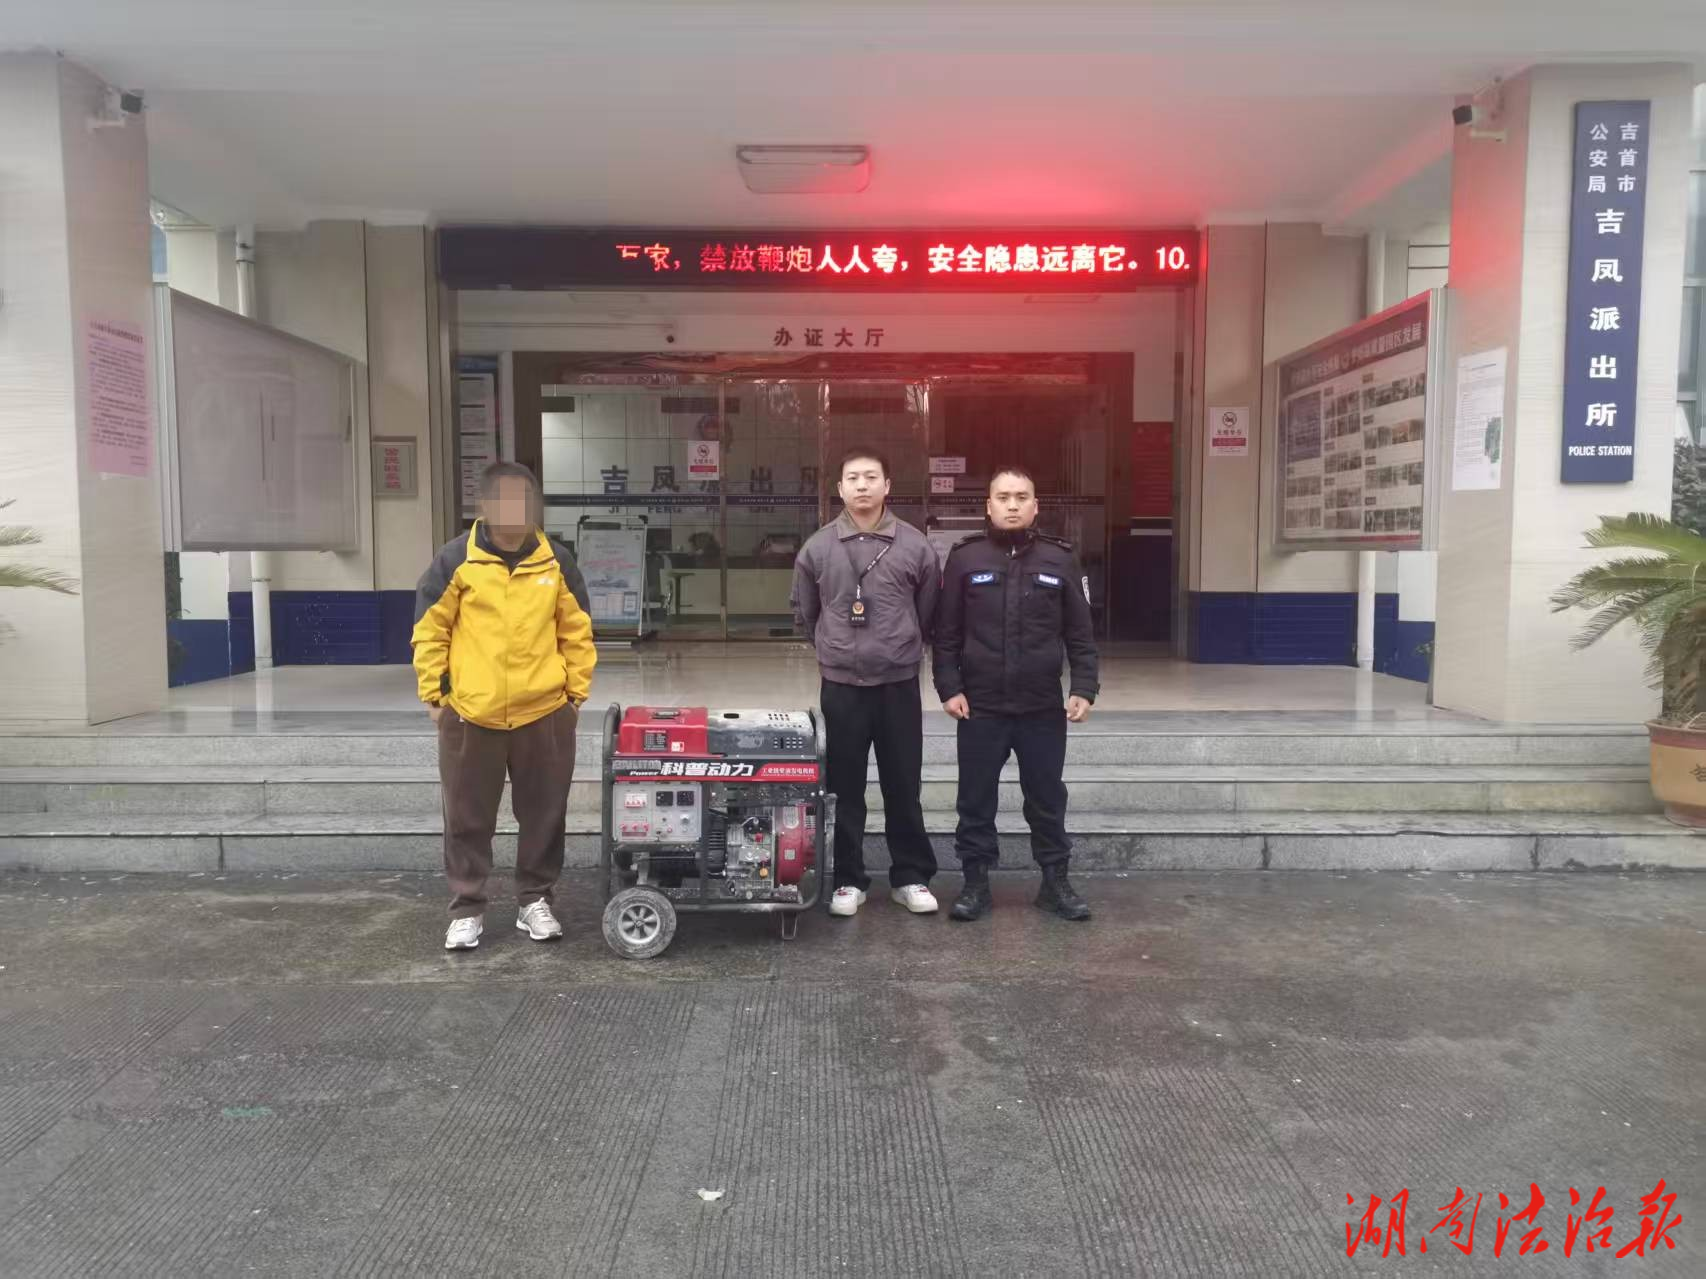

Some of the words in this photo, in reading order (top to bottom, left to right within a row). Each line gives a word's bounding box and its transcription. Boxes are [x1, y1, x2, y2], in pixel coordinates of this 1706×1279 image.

[1587, 123, 1609, 193] 公安局
[1617, 122, 1640, 193] 吉首市
[774, 327, 884, 347] 办证大厅
[1585, 208, 1625, 427] 吉凤派出所
[1568, 446, 1596, 456] POLICE
[1598, 445, 1632, 456] STATION
[660, 762, 754, 777] 科普动力
